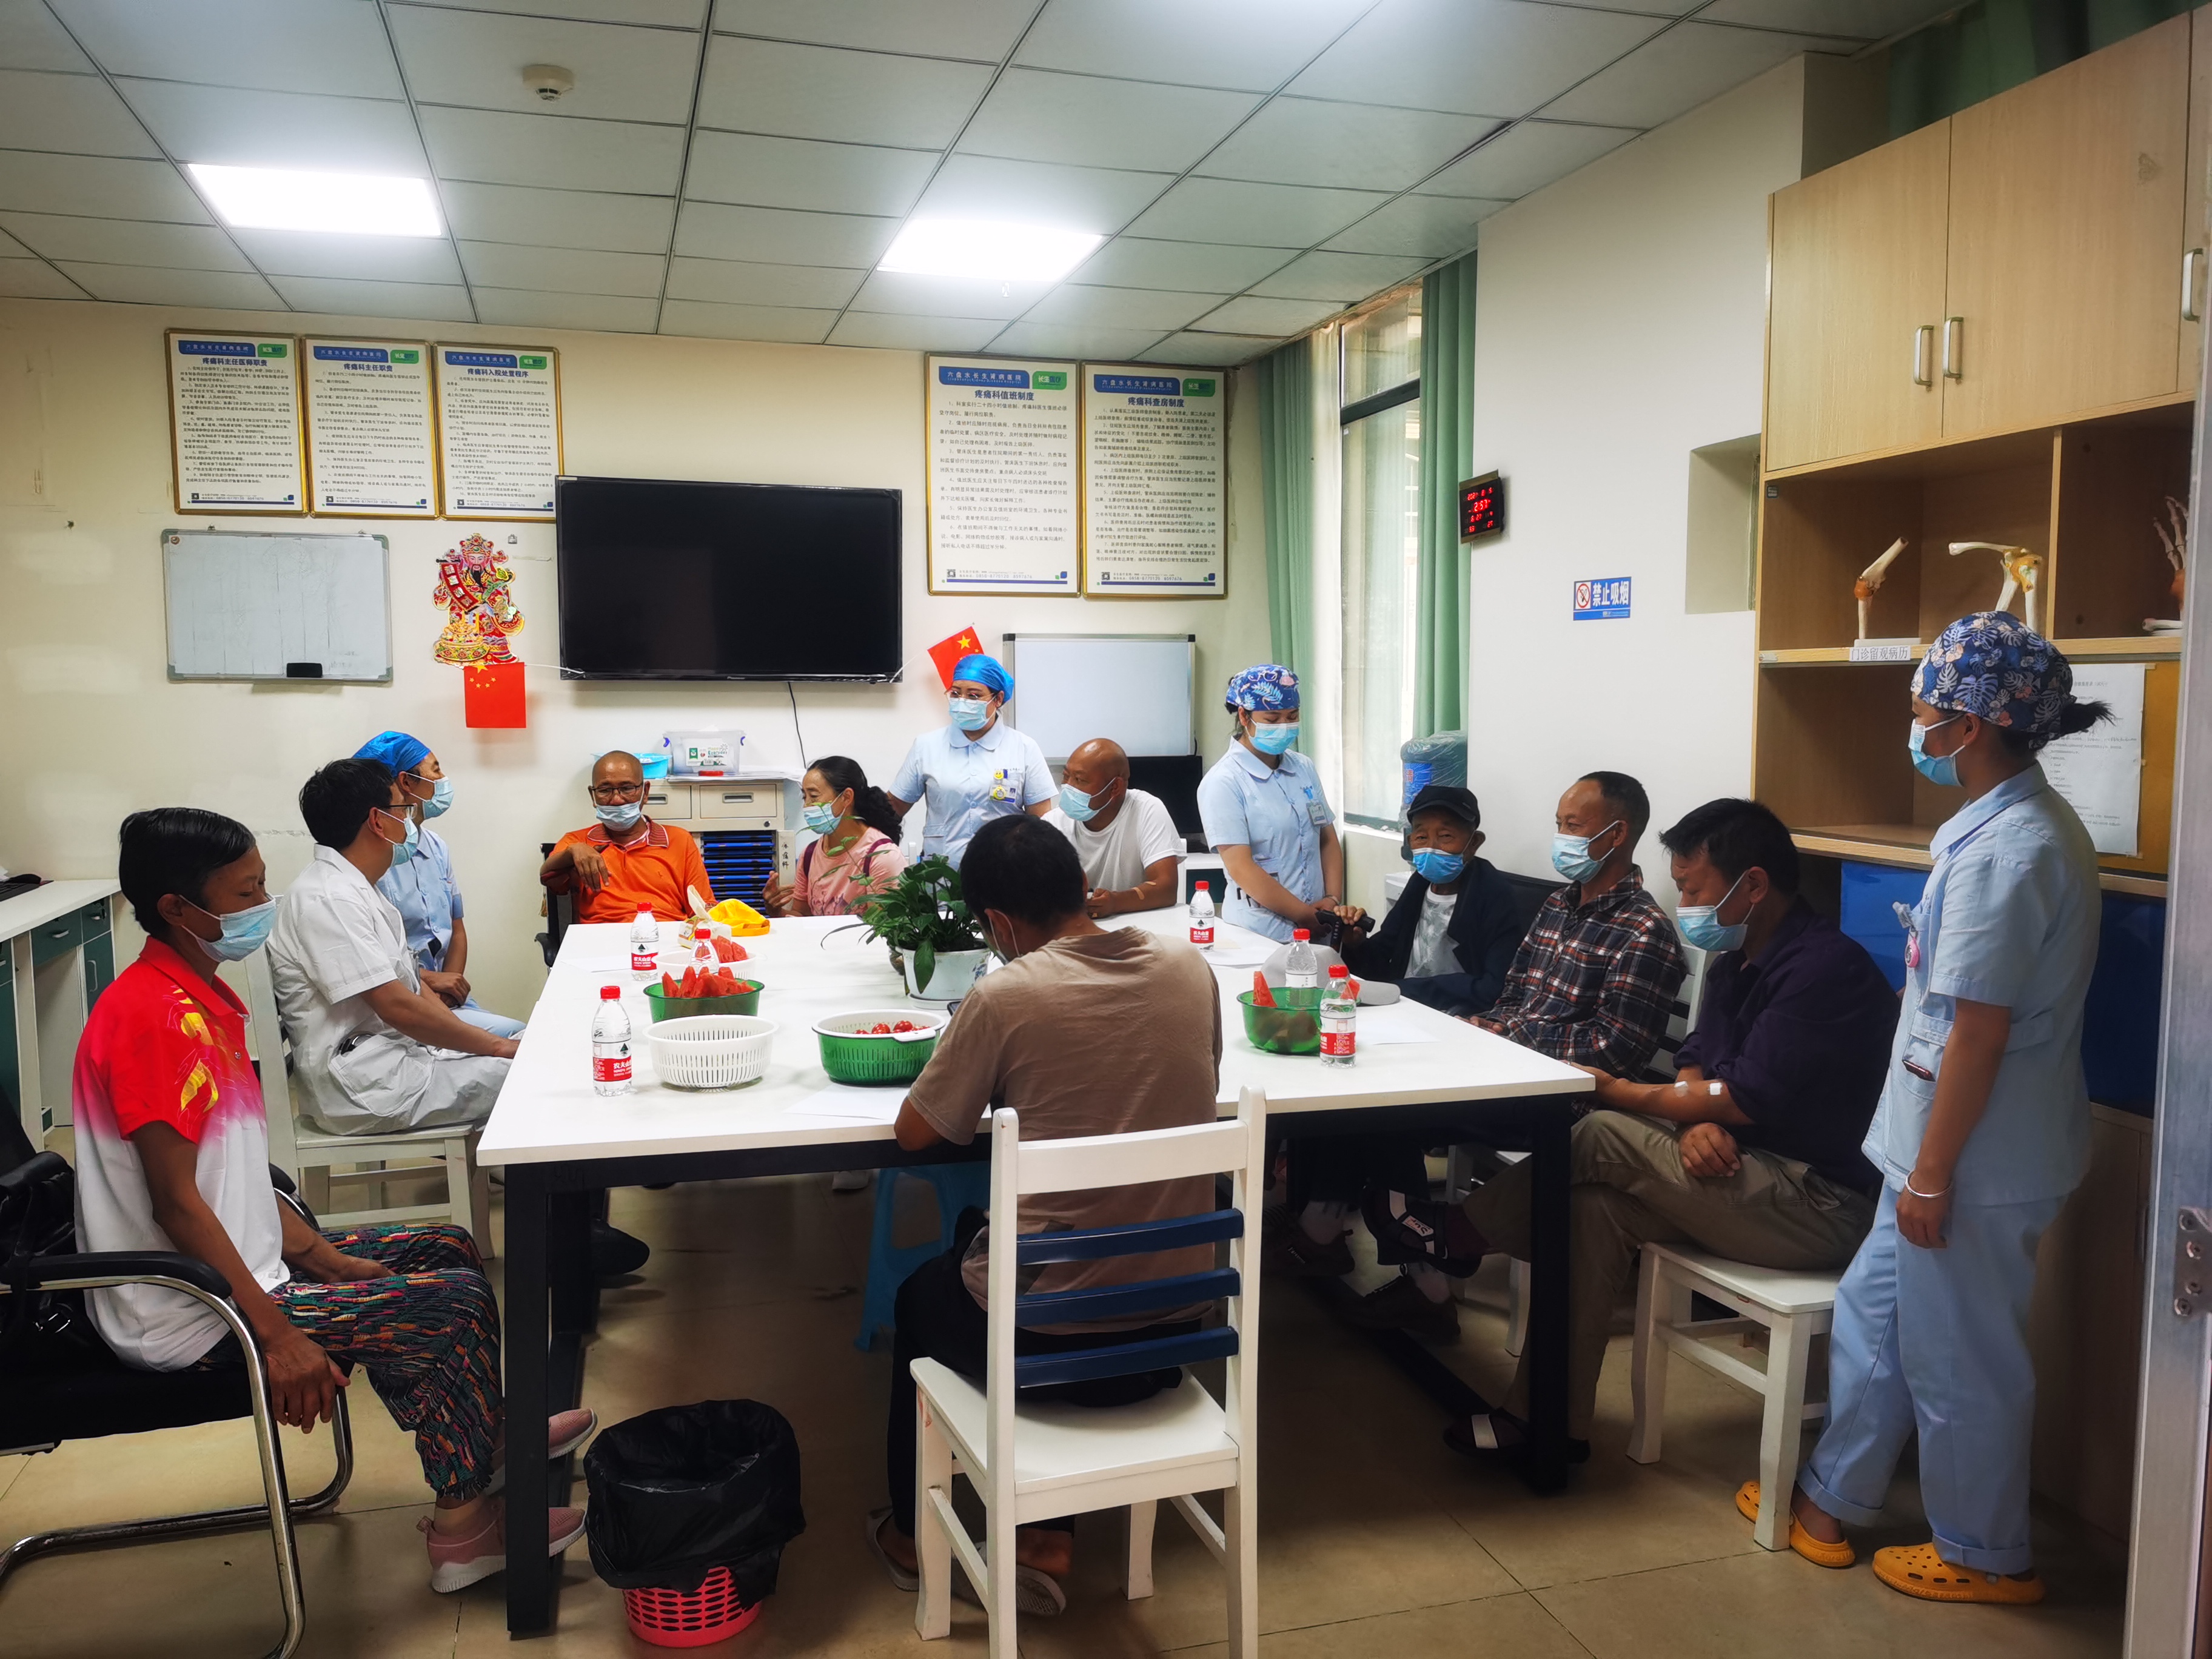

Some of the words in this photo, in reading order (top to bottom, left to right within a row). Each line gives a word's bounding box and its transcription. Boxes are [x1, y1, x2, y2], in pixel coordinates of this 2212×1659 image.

[203, 357, 267, 366] 疼痛科主任医师职责
[343, 363, 393, 372] 疼痛科主任职责
[467, 368, 529, 378] 疼痛科入院处置程序
[974, 390, 1034, 401] 疼痛科值班制度
[1128, 397, 1185, 407] 疼痛科查房制度
[1592, 580, 1629, 608] 禁止吸烟
[1851, 646, 1909, 660] 门诊留观病历
